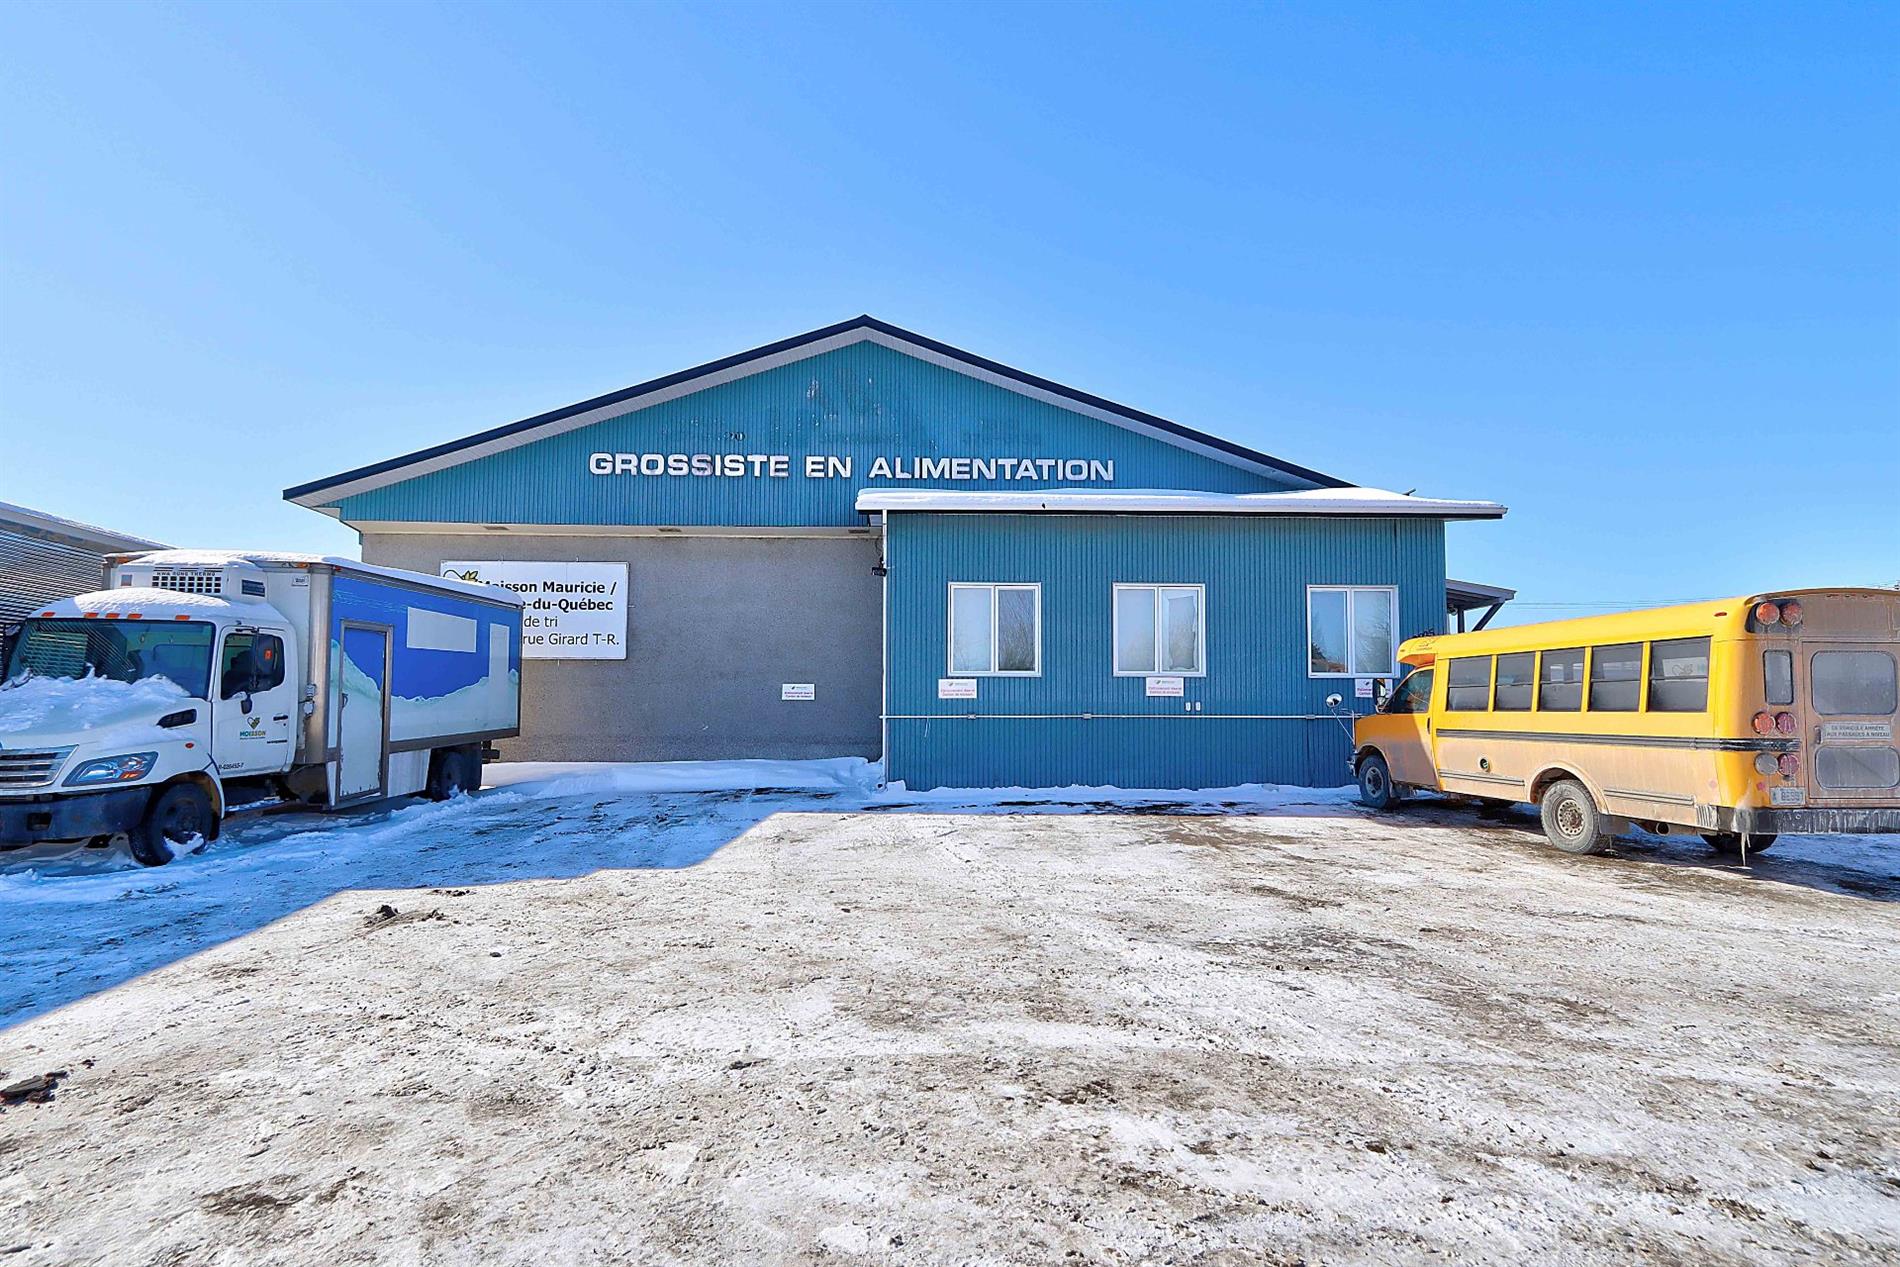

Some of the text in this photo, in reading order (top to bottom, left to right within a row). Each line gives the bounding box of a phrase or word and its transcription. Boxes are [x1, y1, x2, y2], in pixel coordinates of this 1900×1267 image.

[589, 452, 1114, 482] GROSSISTE EN ALIMENTATION
[478, 580, 617, 595] isson Mauricie /
[523, 615, 558, 628] de tri
[523, 632, 620, 645] rue Girard T-R.
